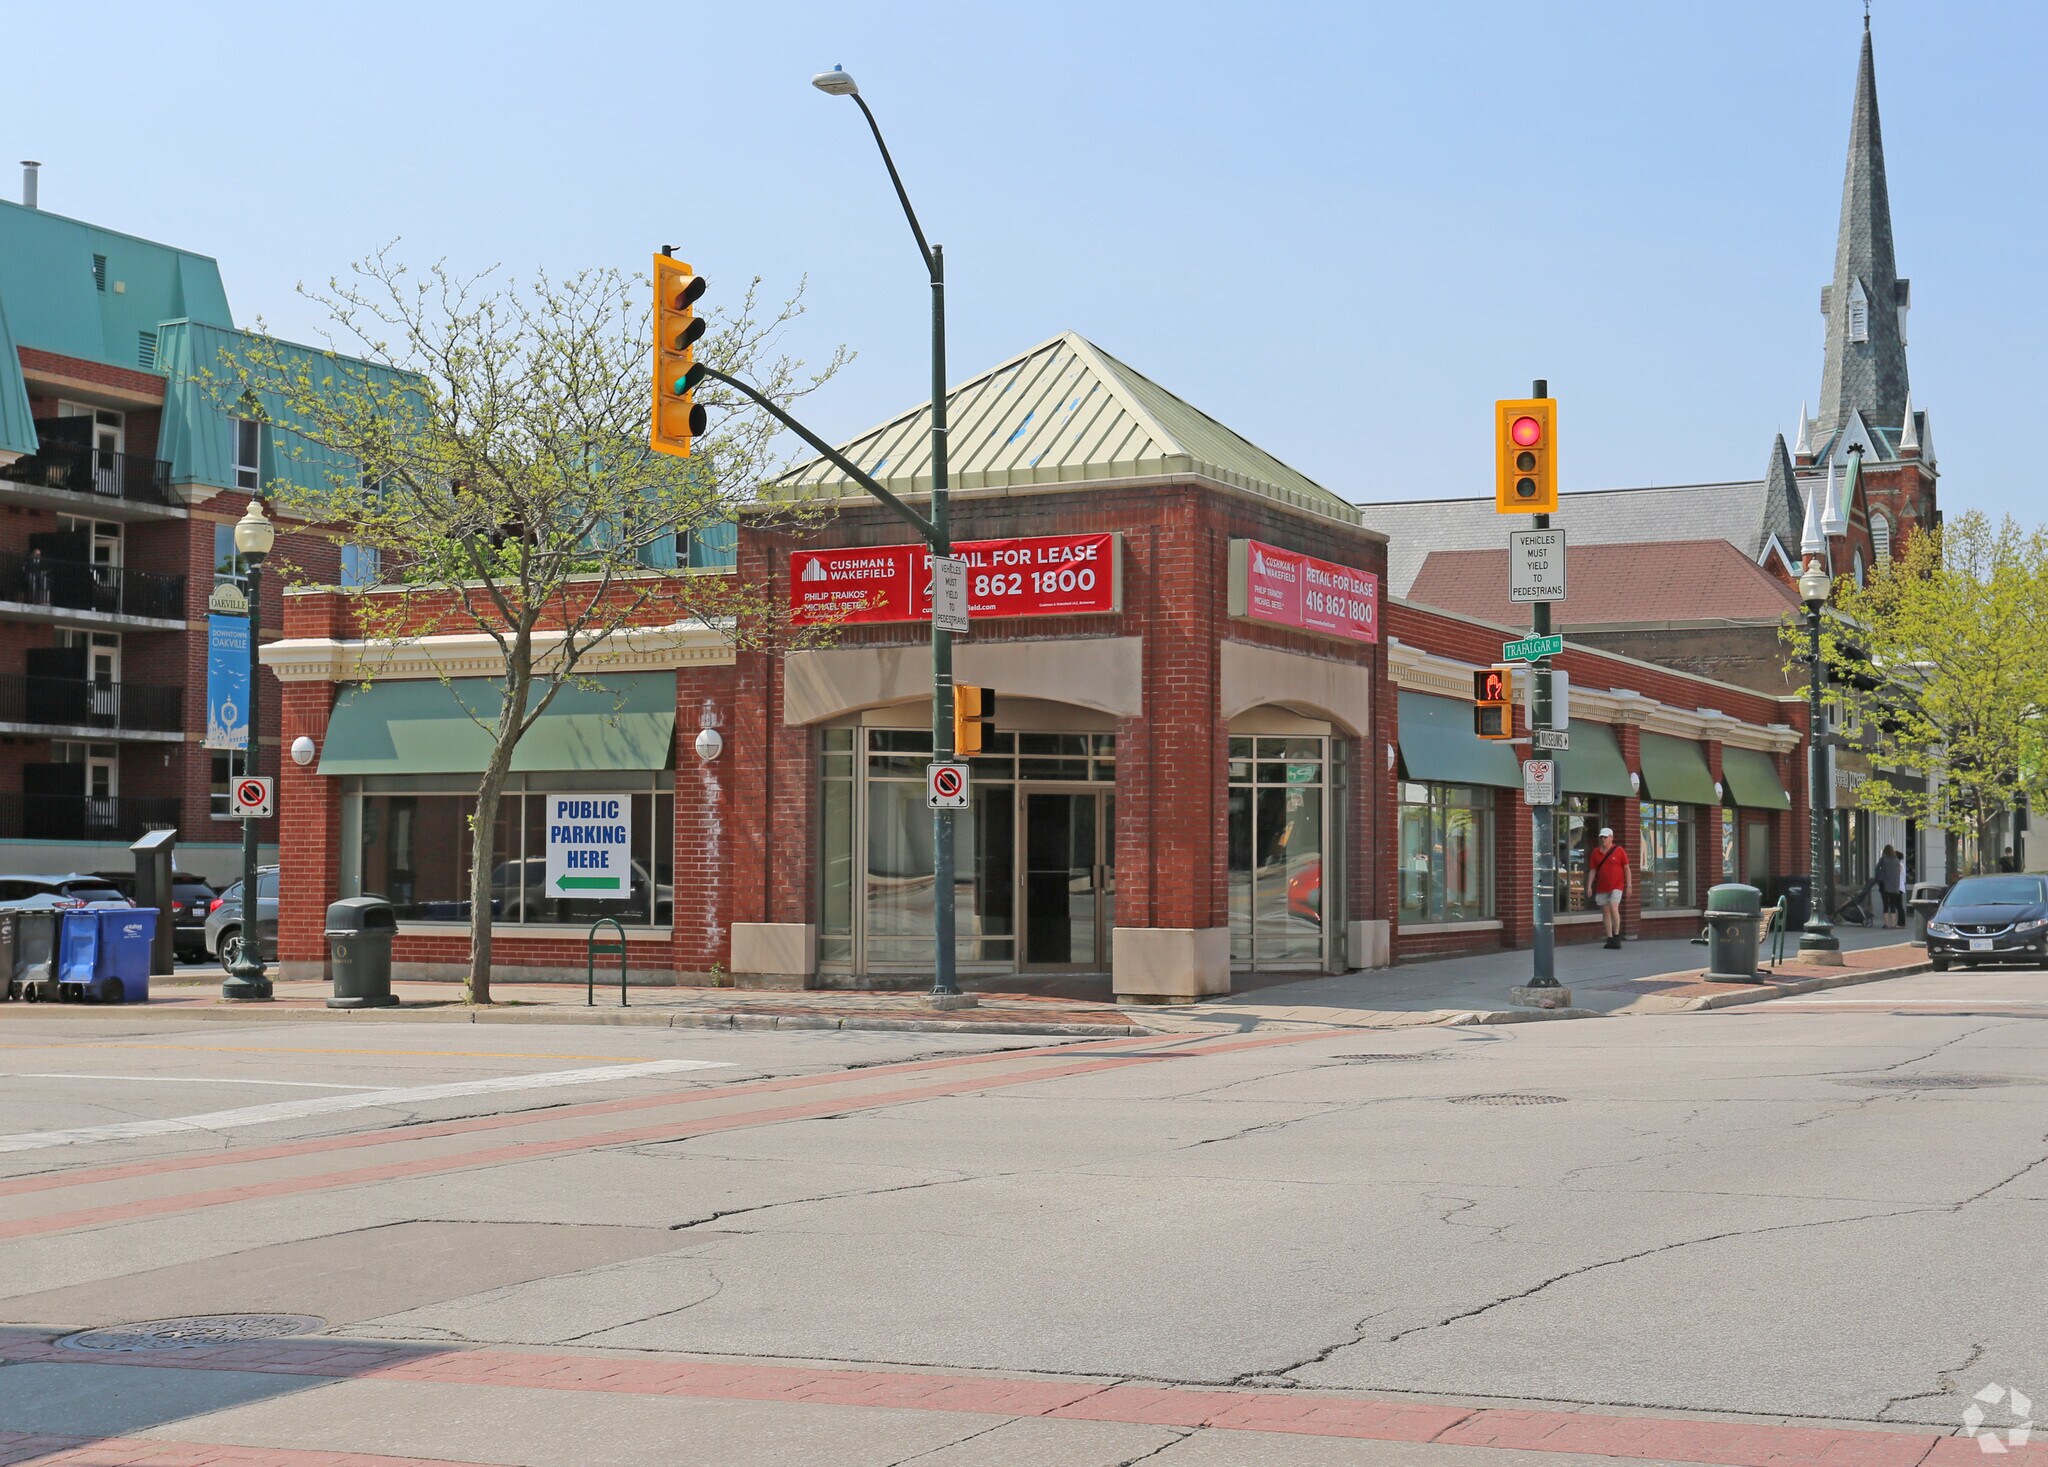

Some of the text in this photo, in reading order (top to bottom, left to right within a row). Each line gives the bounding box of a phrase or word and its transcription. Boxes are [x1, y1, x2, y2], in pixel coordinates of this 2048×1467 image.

[1520, 535, 1555, 546] VEHICLES
[923, 544, 1098, 570] RTAIL FOR LEASE
[1527, 548, 1547, 558] MUST
[830, 557, 895, 570] CUSHMAN &
[941, 563, 962, 575] VEHICLES
[1266, 557, 1296, 573] CUSHMAN &
[1527, 561, 1549, 570] YIELD
[830, 568, 896, 581] WAKEFIELD
[1266, 567, 1296, 584] WAKEFIELD
[1533, 573, 1543, 583] TO
[945, 577, 957, 587] MUST
[974, 572, 1023, 597] 862
[1031, 568, 1096, 594] 1800
[1306, 567, 1373, 598] RETAIL FOR LEASE
[804, 592, 829, 600] PHILIP
[945, 590, 958, 600] YIELD
[1512, 585, 1563, 596] PEDESTRIANS
[211, 598, 247, 610] OAKVILLE
[949, 602, 955, 612] TO
[1306, 590, 1323, 612] 416
[1326, 594, 1346, 618] 862
[1348, 599, 1373, 624] 1800
[937, 613, 967, 626] PEDESTRIANS
[212, 629, 248, 639] DOWNTOWN
[212, 637, 247, 649] OAKVILLE
[1505, 639, 1560, 657] TRAFALGAR RD
[1541, 731, 1563, 748] MUSEUMS
[557, 800, 619, 819] PUBLIC
[551, 825, 626, 844] PARKING
[567, 850, 609, 868] HERE
